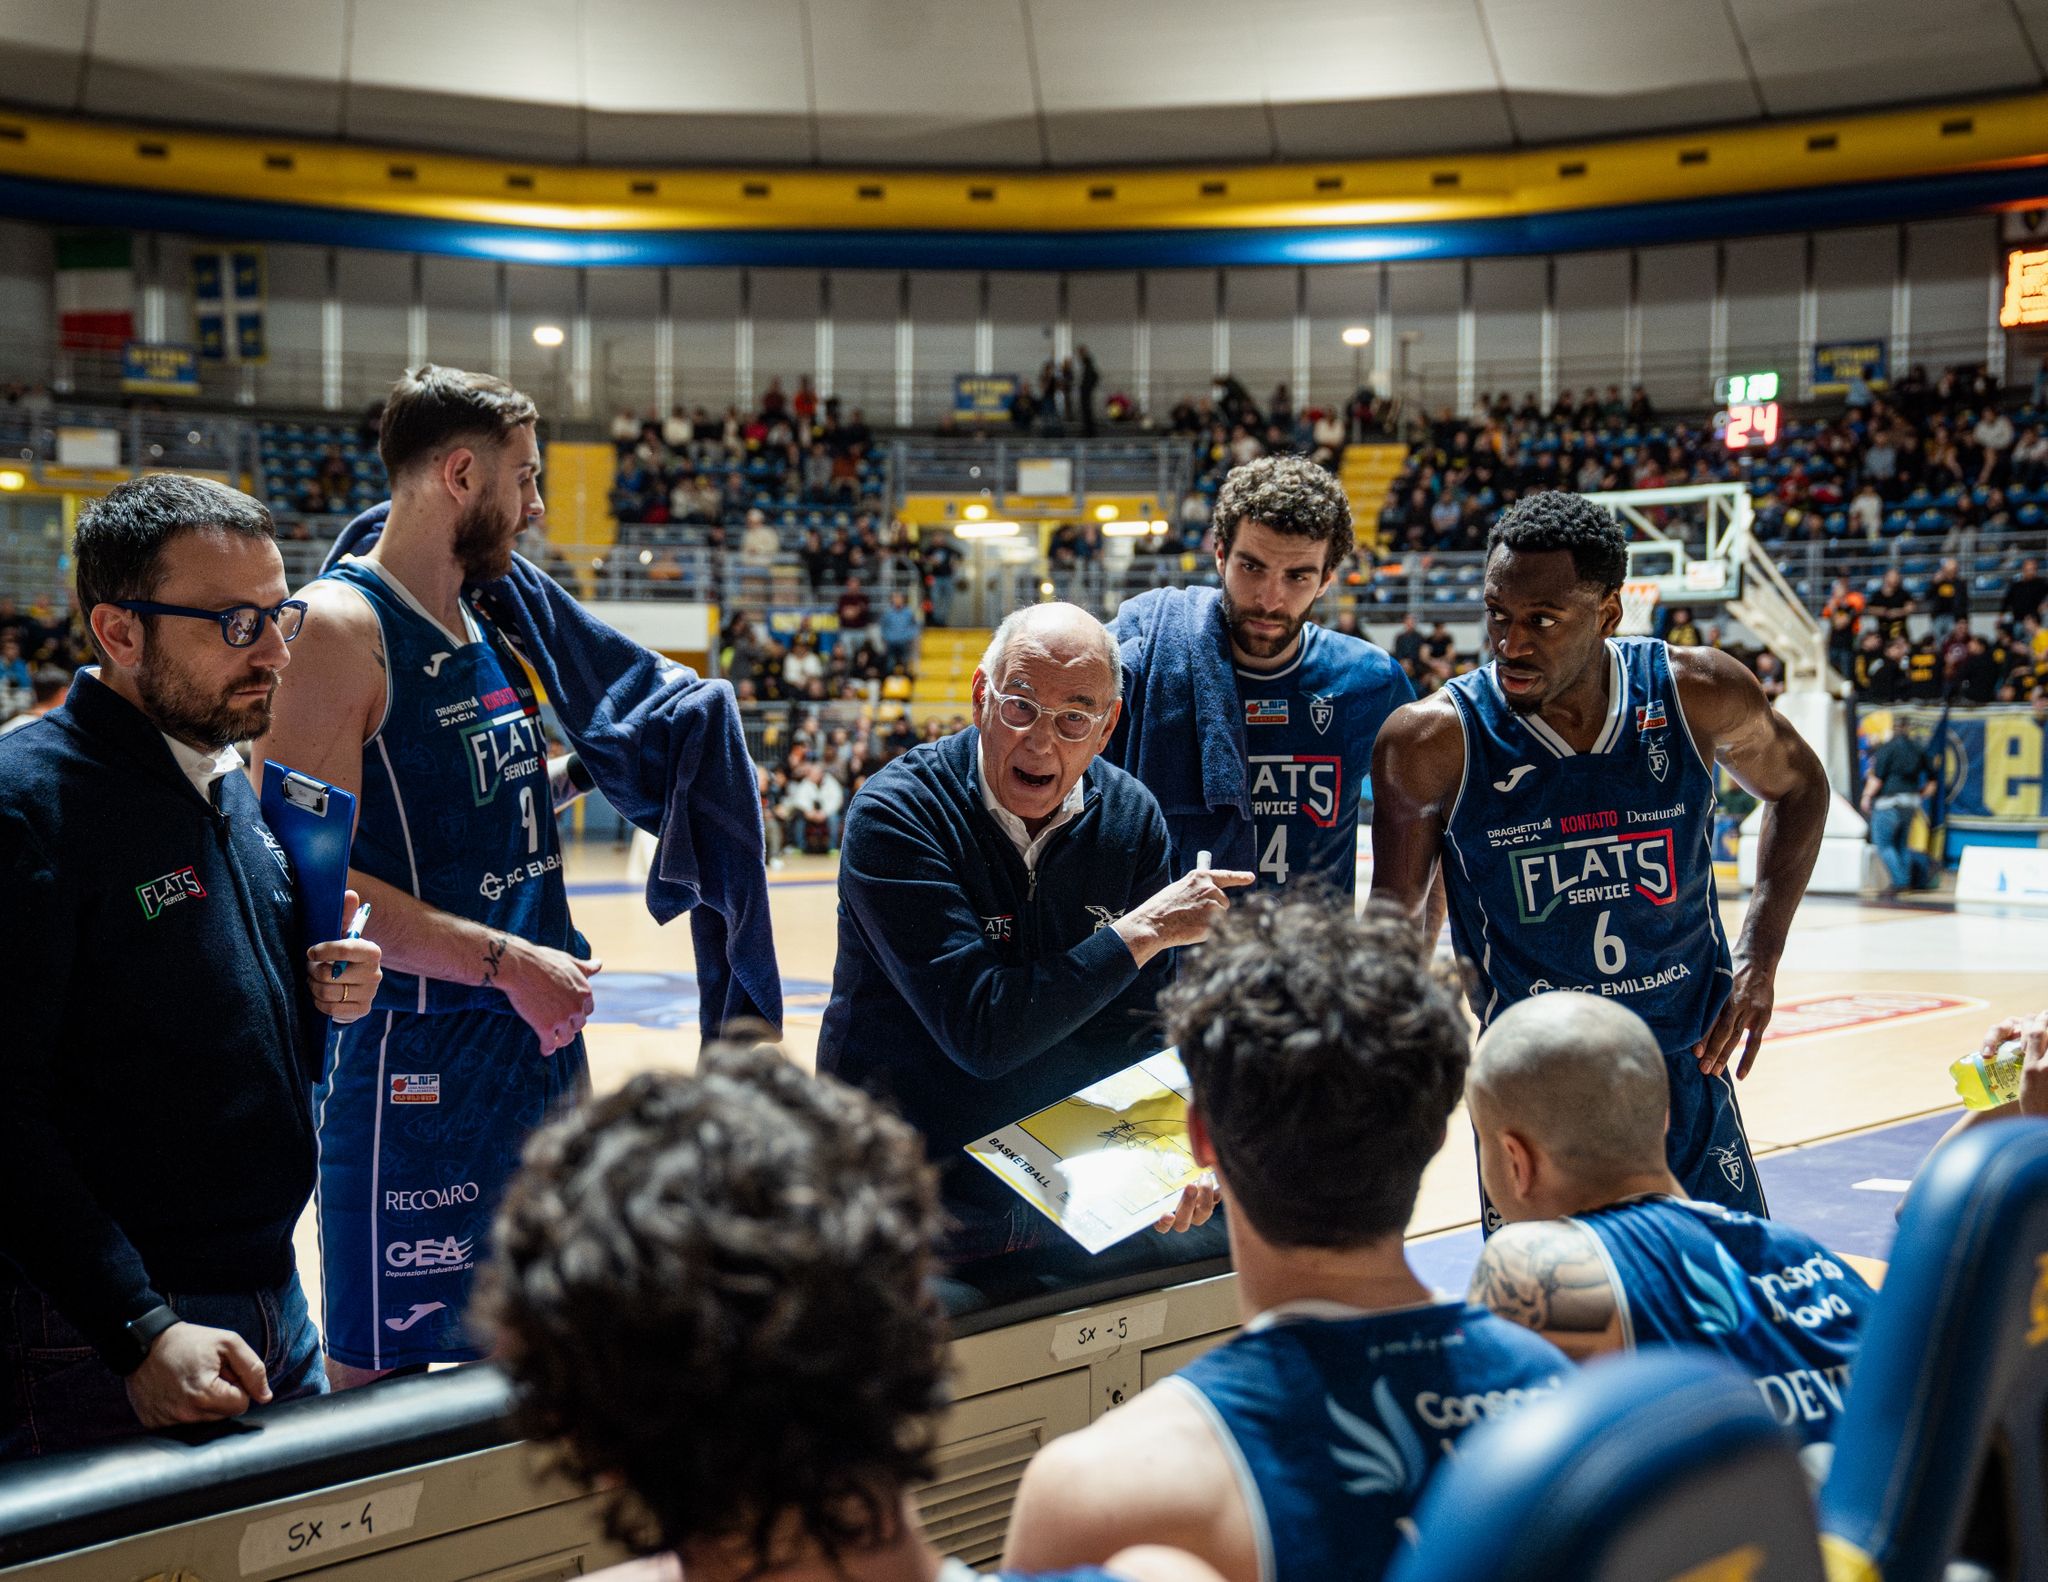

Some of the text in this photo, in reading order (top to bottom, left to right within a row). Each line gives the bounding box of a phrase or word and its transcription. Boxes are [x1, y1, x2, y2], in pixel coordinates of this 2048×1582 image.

[1726, 403, 1779, 449] 24
[1252, 764, 1334, 816] ATS
[519, 786, 538, 854] 9
[1487, 822, 1541, 838] DRAGHETTI
[1560, 810, 1618, 834] KONTATTO
[1490, 834, 1542, 847] DACIA
[1521, 840, 1668, 911] FLATS
[141, 870, 201, 914] FLATS
[1568, 882, 1630, 905] SERVICE
[1594, 910, 1627, 975] 6
[1601, 963, 1691, 996] EMILBANCA
[408, 1076, 438, 1085] LNP
[988, 1137, 1052, 1188] BASKETBALL
[386, 1182, 479, 1210] RECOARO
[386, 1236, 464, 1267] GEA
[385, 1269, 428, 1278] Depurazioni
[429, 1263, 463, 1274] Industriali
[1118, 1316, 1127, 1338] 5
[360, 1502, 373, 1534] 4
